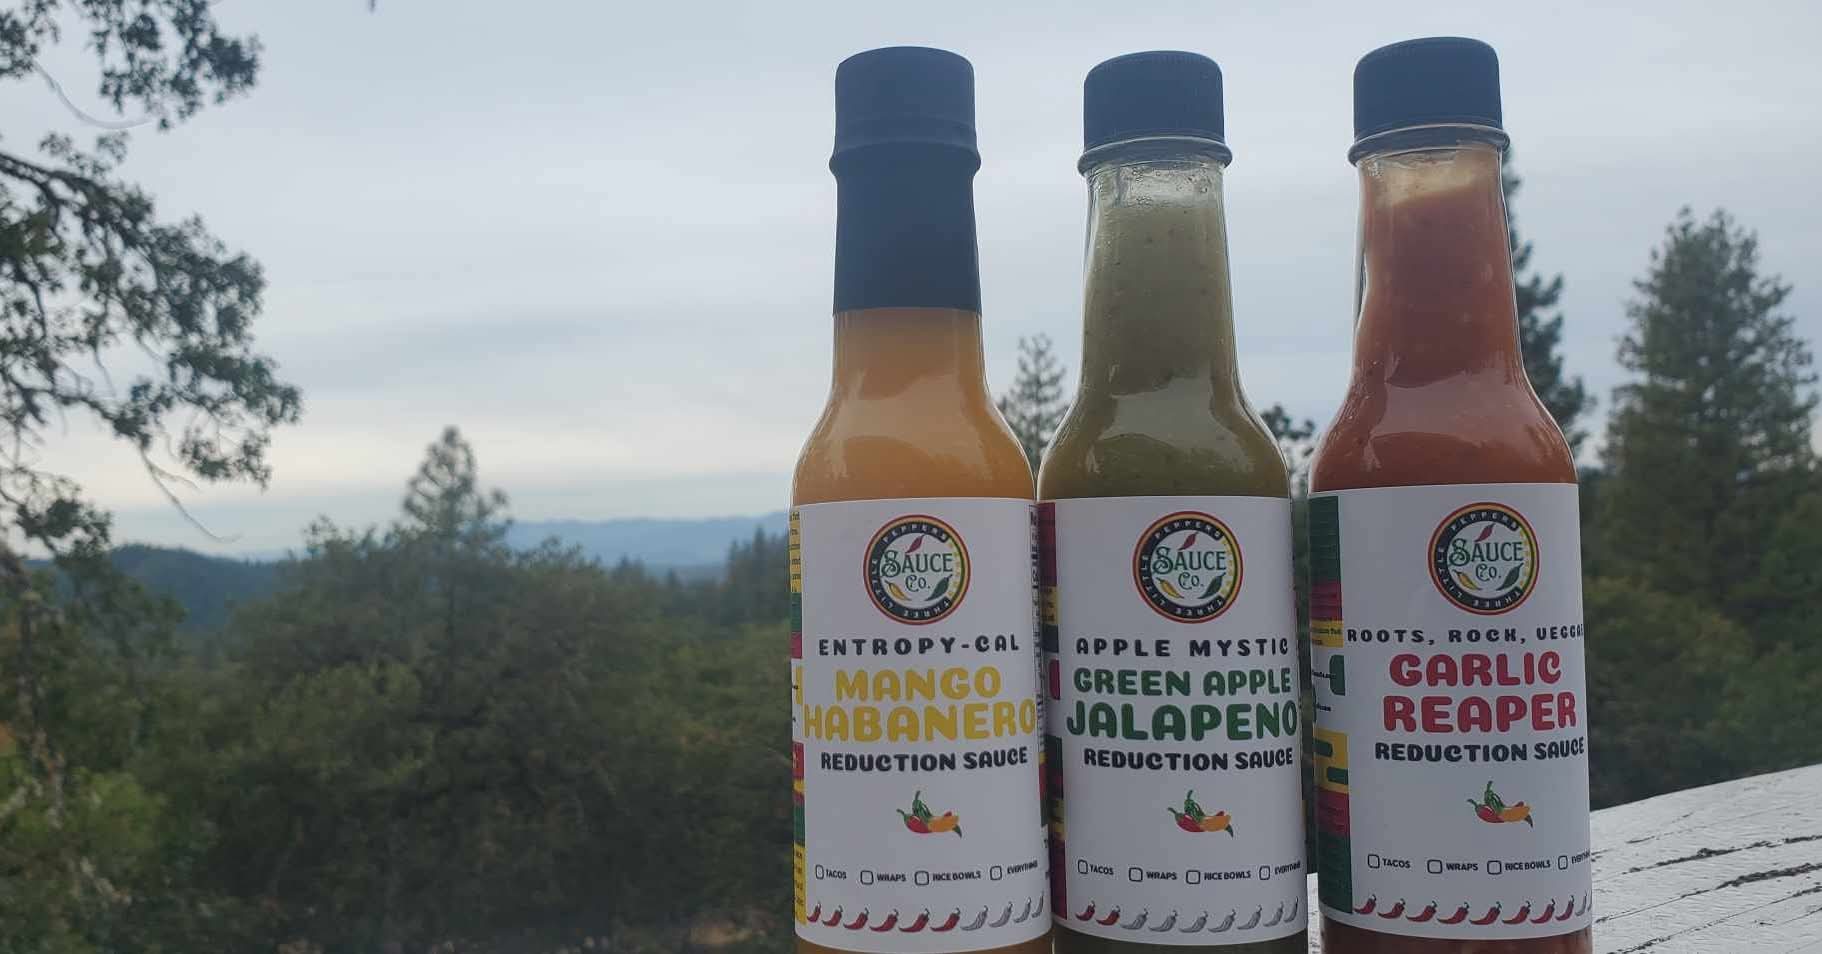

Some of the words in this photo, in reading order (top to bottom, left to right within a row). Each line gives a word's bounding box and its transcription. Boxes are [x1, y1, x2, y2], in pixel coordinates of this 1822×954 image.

[881, 549, 953, 578] SAUCE
[1152, 545, 1227, 575] SAUCE
[1449, 538, 1524, 567] SAUCE
[818, 634, 1020, 656] ENTROPY-CAL
[1076, 637, 1171, 657] APPLE
[1189, 637, 1289, 657] MYSTIC
[1347, 628, 1436, 645] ROOTS,
[1389, 650, 1562, 687] GARLIC
[835, 665, 1001, 702] MANGO
[1073, 667, 1192, 697] GREEN
[1202, 667, 1291, 697] APPLE
[803, 698, 1037, 743] HABANERO
[1066, 699, 1298, 742] JALAPENO
[1382, 691, 1577, 733] REAPER
[820, 751, 957, 773] REDUCTION
[962, 746, 1028, 770] SAUCE
[1083, 747, 1229, 771] REDUCTION
[1234, 747, 1294, 771] SAUCE
[1374, 741, 1528, 763] REDUCTION
[1533, 736, 1585, 761] SAUCE
[825, 870, 847, 880] TACOS
[1090, 863, 1115, 876] TACOS
[1223, 870, 1251, 880] BOWLS
[1382, 857, 1411, 869] TACOS
[1446, 862, 1478, 872] WRAPS
[1504, 862, 1524, 872] RICE
[1524, 860, 1551, 870] BOWLS
[876, 873, 907, 883] WRAPS
[1146, 871, 1178, 881] WRAPS
